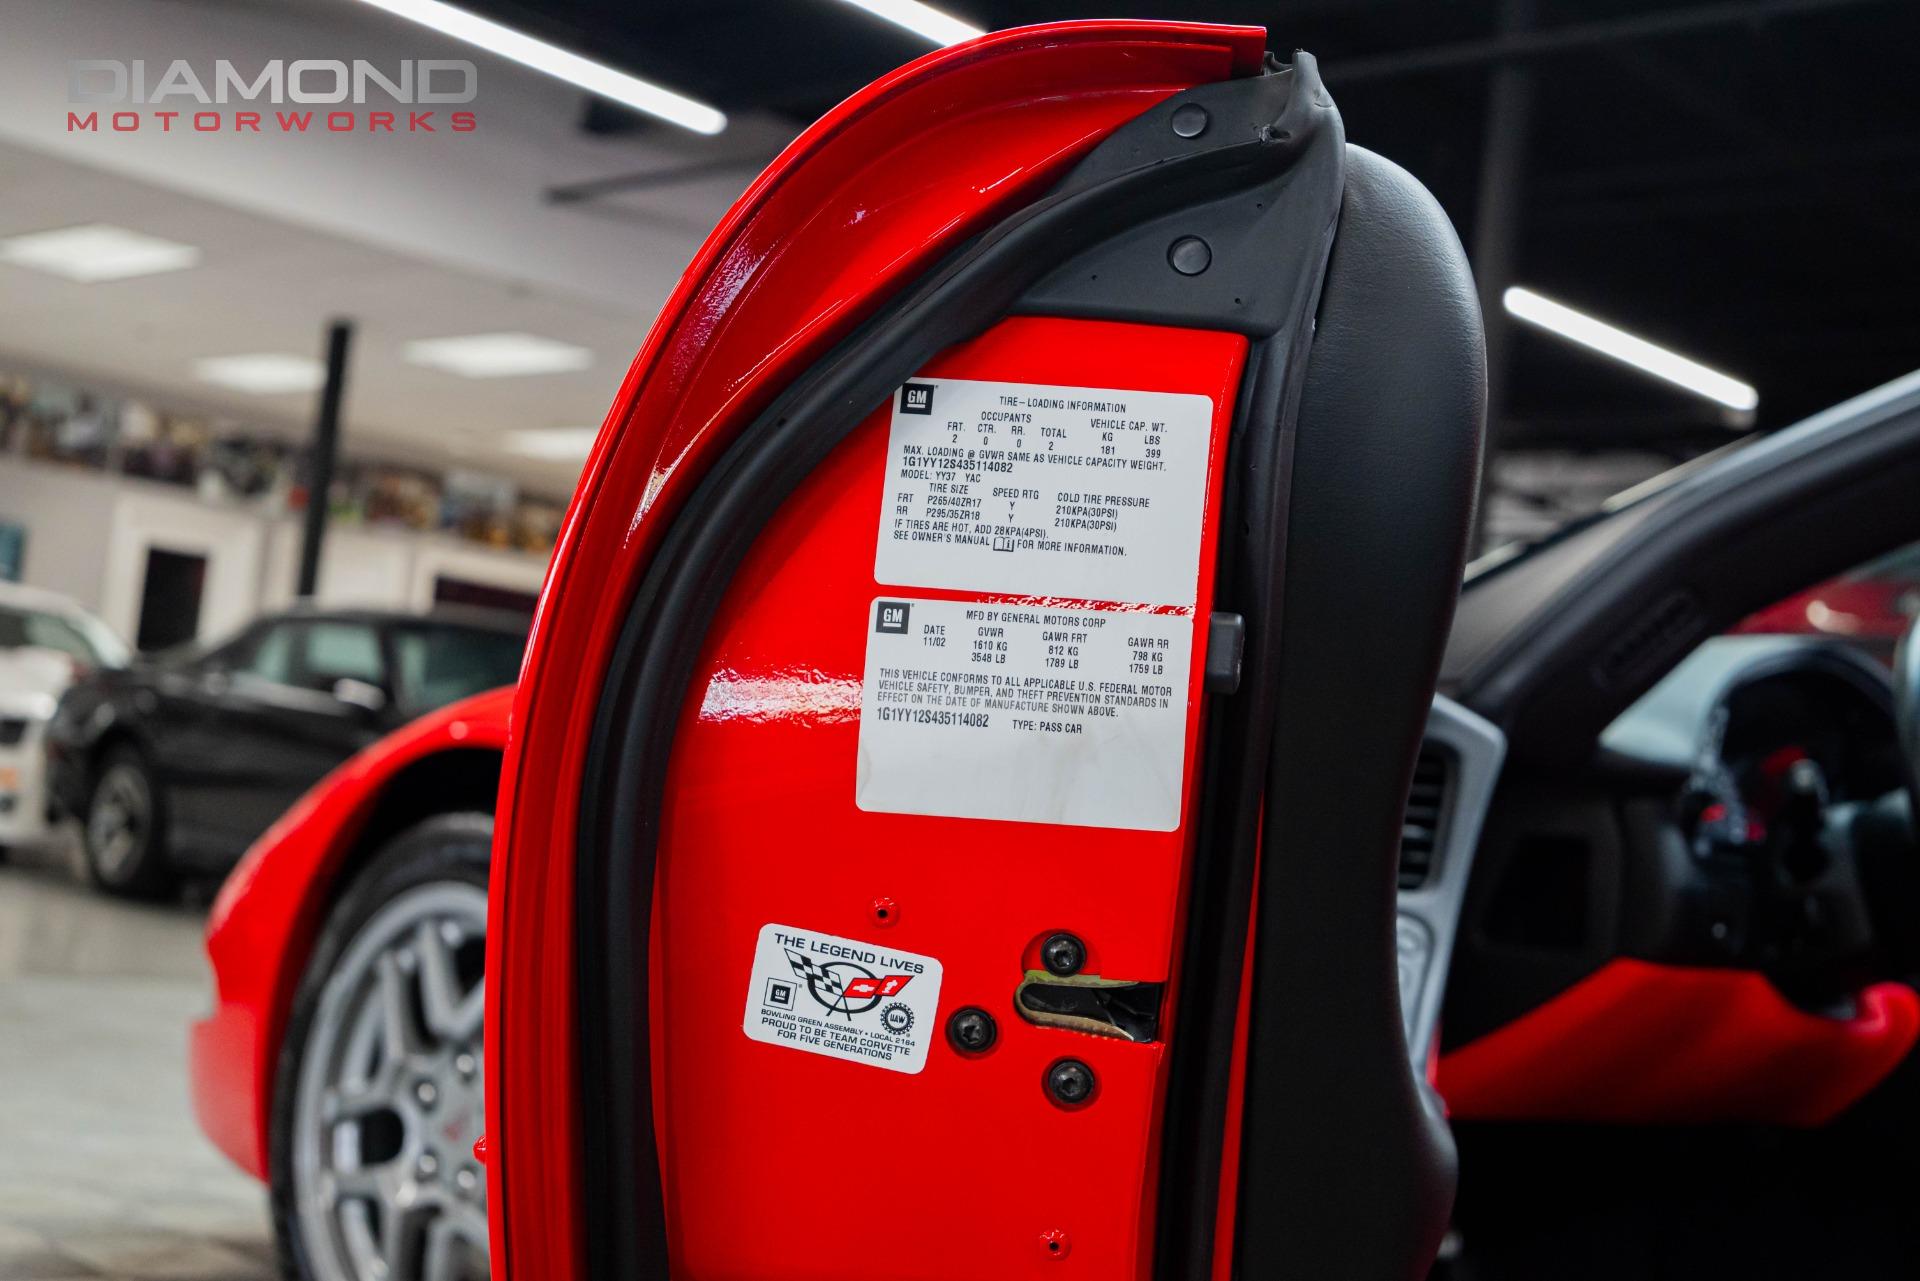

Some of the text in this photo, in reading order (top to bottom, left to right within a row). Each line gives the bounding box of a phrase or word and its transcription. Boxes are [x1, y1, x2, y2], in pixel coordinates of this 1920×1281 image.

[907, 389, 928, 404] GM
[1067, 401, 1126, 413] INFORMATION
[981, 411, 1032, 423] OCCUPANTS
[1091, 419, 1126, 430] VEHICLE
[952, 434, 957, 443] 2
[1041, 428, 1066, 438] TOTAL
[1102, 432, 1113, 441] KG
[984, 437, 988, 445] 0
[1017, 439, 1022, 448] 0
[1049, 441, 1054, 451] 2
[1145, 435, 1160, 445] LBS
[1101, 446, 1115, 455] 181
[1146, 449, 1161, 458] 399
[928, 447, 964, 458] LOADING
[979, 450, 1004, 460] GVWR
[1008, 452, 1030, 462] SAME
[1033, 454, 1044, 463] AS
[1048, 454, 1082, 465] VEHICLE
[1086, 457, 1127, 468] CAPACITY
[904, 456, 1013, 473] 1G1YY12S435114082
[936, 471, 956, 481] YY37
[966, 473, 980, 483] YAC
[930, 483, 968, 494] TIRE SIZE
[993, 488, 1039, 500] SPEED RTG
[898, 493, 914, 502] FRT
[928, 496, 982, 508] P265/40ZR17
[1058, 493, 1150, 507] COLD TIRE PRESSURE
[897, 506, 908, 515] RR
[1010, 502, 1015, 510] Y
[926, 508, 980, 520] P295/35ZR18
[1009, 514, 1014, 523] Y
[895, 519, 903, 528] IF
[906, 520, 930, 530] TIRES
[932, 521, 949, 532] ARE
[975, 524, 992, 534] ADD
[894, 530, 909, 540] SEE
[955, 534, 990, 546] MANUAL
[1017, 539, 1034, 549] FOR
[1038, 541, 1062, 551] MORE
[883, 608, 903, 623] GM
[966, 610, 1106, 628] MFD BY GENERAL MOTORS CORP
[924, 625, 945, 635] DATE
[978, 627, 1004, 638] GVWR
[924, 636, 946, 647] 11/02
[1043, 632, 1087, 643] GAWR FRT
[1128, 637, 1169, 649] GAWR RR
[974, 640, 1007, 651] 1610 KG
[1049, 645, 1078, 656] 812 KG
[972, 652, 1006, 664] 3548 LB
[1133, 651, 1162, 662] 798 KG
[1046, 658, 1079, 669] 1789 LB
[1129, 664, 1163, 675] 1759 LB
[880, 668, 899, 678] THIS
[903, 670, 937, 681] VEHICLE
[941, 672, 988, 684] CONFORMS
[992, 676, 1002, 685] TO
[1005, 677, 1020, 686] ALL
[1024, 678, 1075, 690] APPLICABLE
[1100, 682, 1137, 694] FEDERAL
[1141, 685, 1172, 696] MOTOR
[879, 680, 914, 691] VEHICLE
[996, 688, 1014, 698] AND
[1017, 689, 1044, 700] THEFT
[1047, 691, 1101, 704] PREVENTION
[1104, 695, 1156, 708] STANDARDS
[1160, 698, 1168, 708] IN
[878, 692, 908, 702] EFFECT
[912, 694, 923, 704] ON
[927, 695, 942, 705] THE
[946, 696, 967, 706] DATE
[971, 698, 981, 707] OF
[985, 699, 1048, 712] MANUFACTURE
[1052, 704, 1084, 715] SHOWN
[878, 708, 989, 727] 1G1YY12S435114082
[1040, 722, 1062, 732] PASS
[1065, 723, 1082, 734] CAR
[776, 933, 924, 974] THE LEGEND LIVES
[889, 1012, 906, 1024] UAW
[761, 1009, 796, 1021] BOWLING
[798, 1017, 822, 1027] GREEN
[824, 1023, 863, 1035] ASSEMBLY
[870, 1032, 893, 1042] LOCAL
[762, 1017, 910, 1055] PROUD TO BE TEAM CORVETTE
[777, 1030, 892, 1060] FOR FIVE GENERATIONS
